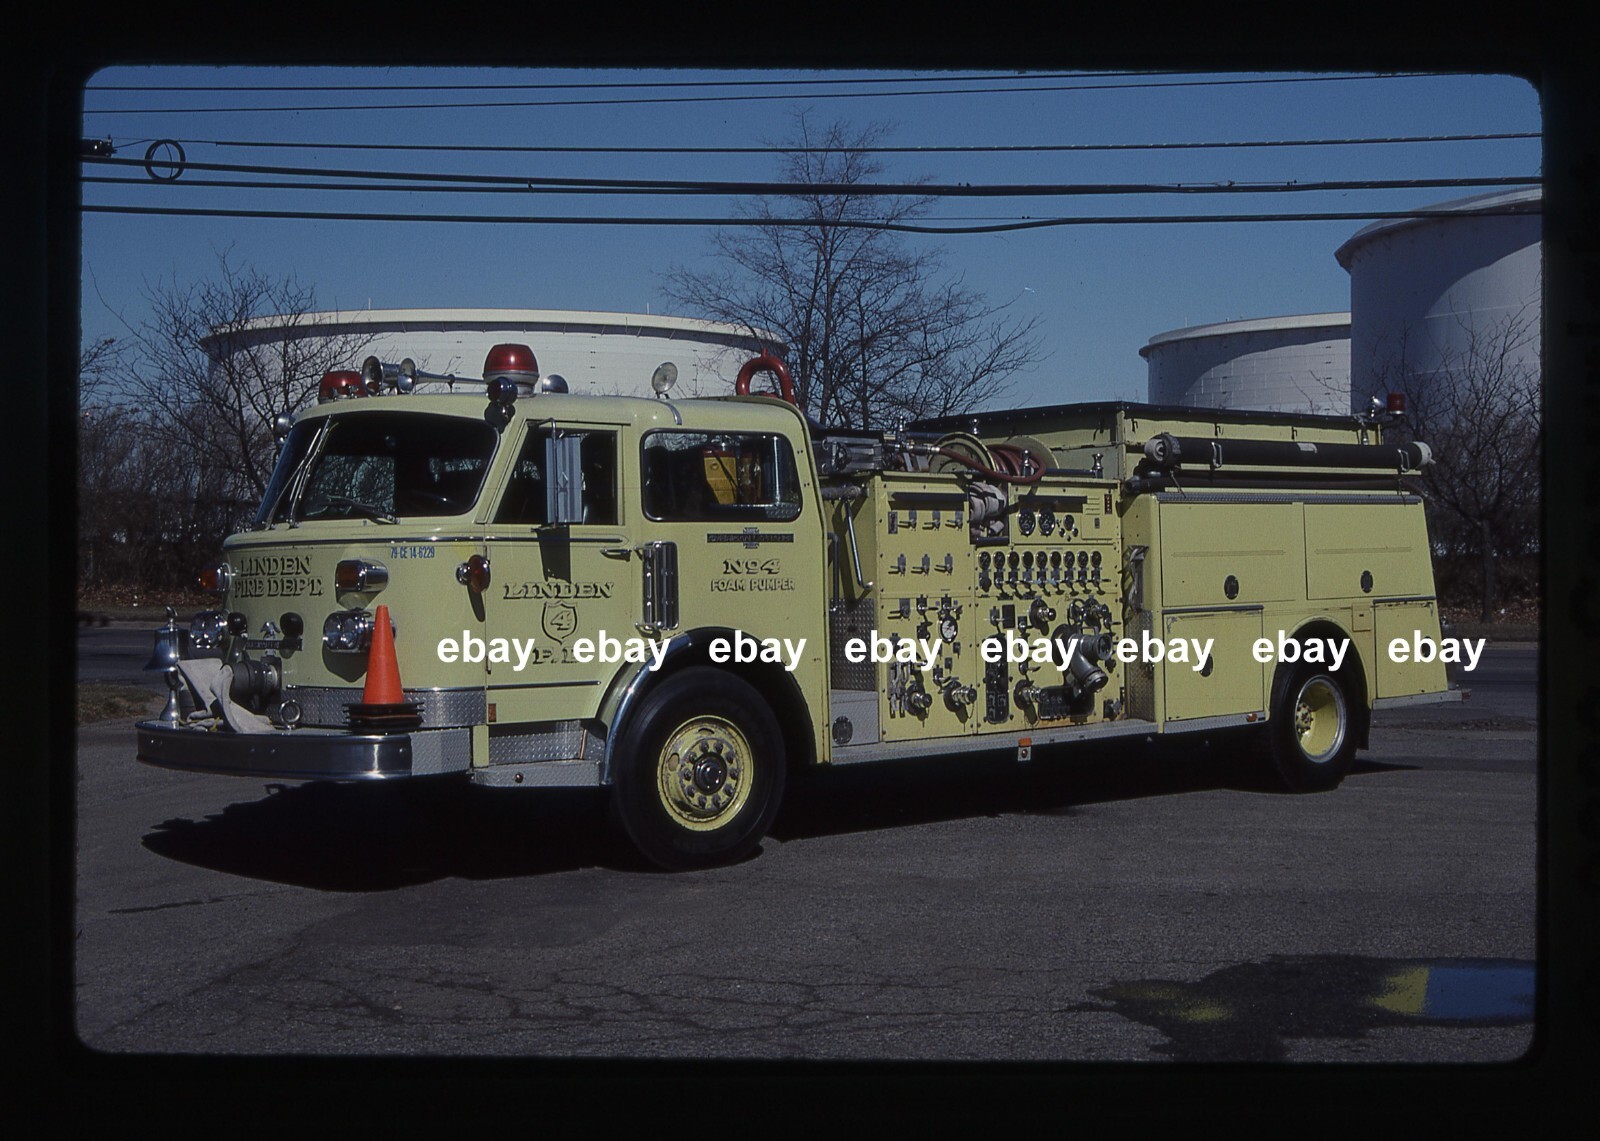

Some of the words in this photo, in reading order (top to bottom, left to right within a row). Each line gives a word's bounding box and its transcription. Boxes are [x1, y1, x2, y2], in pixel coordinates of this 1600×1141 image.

[240, 555, 313, 577] LINDEN
[234, 577, 264, 599] FIRE
[503, 581, 615, 600] LINDEN
[710, 578, 746, 592] FOAM
[749, 578, 795, 592] PUMPER
[550, 610, 572, 631] 4
